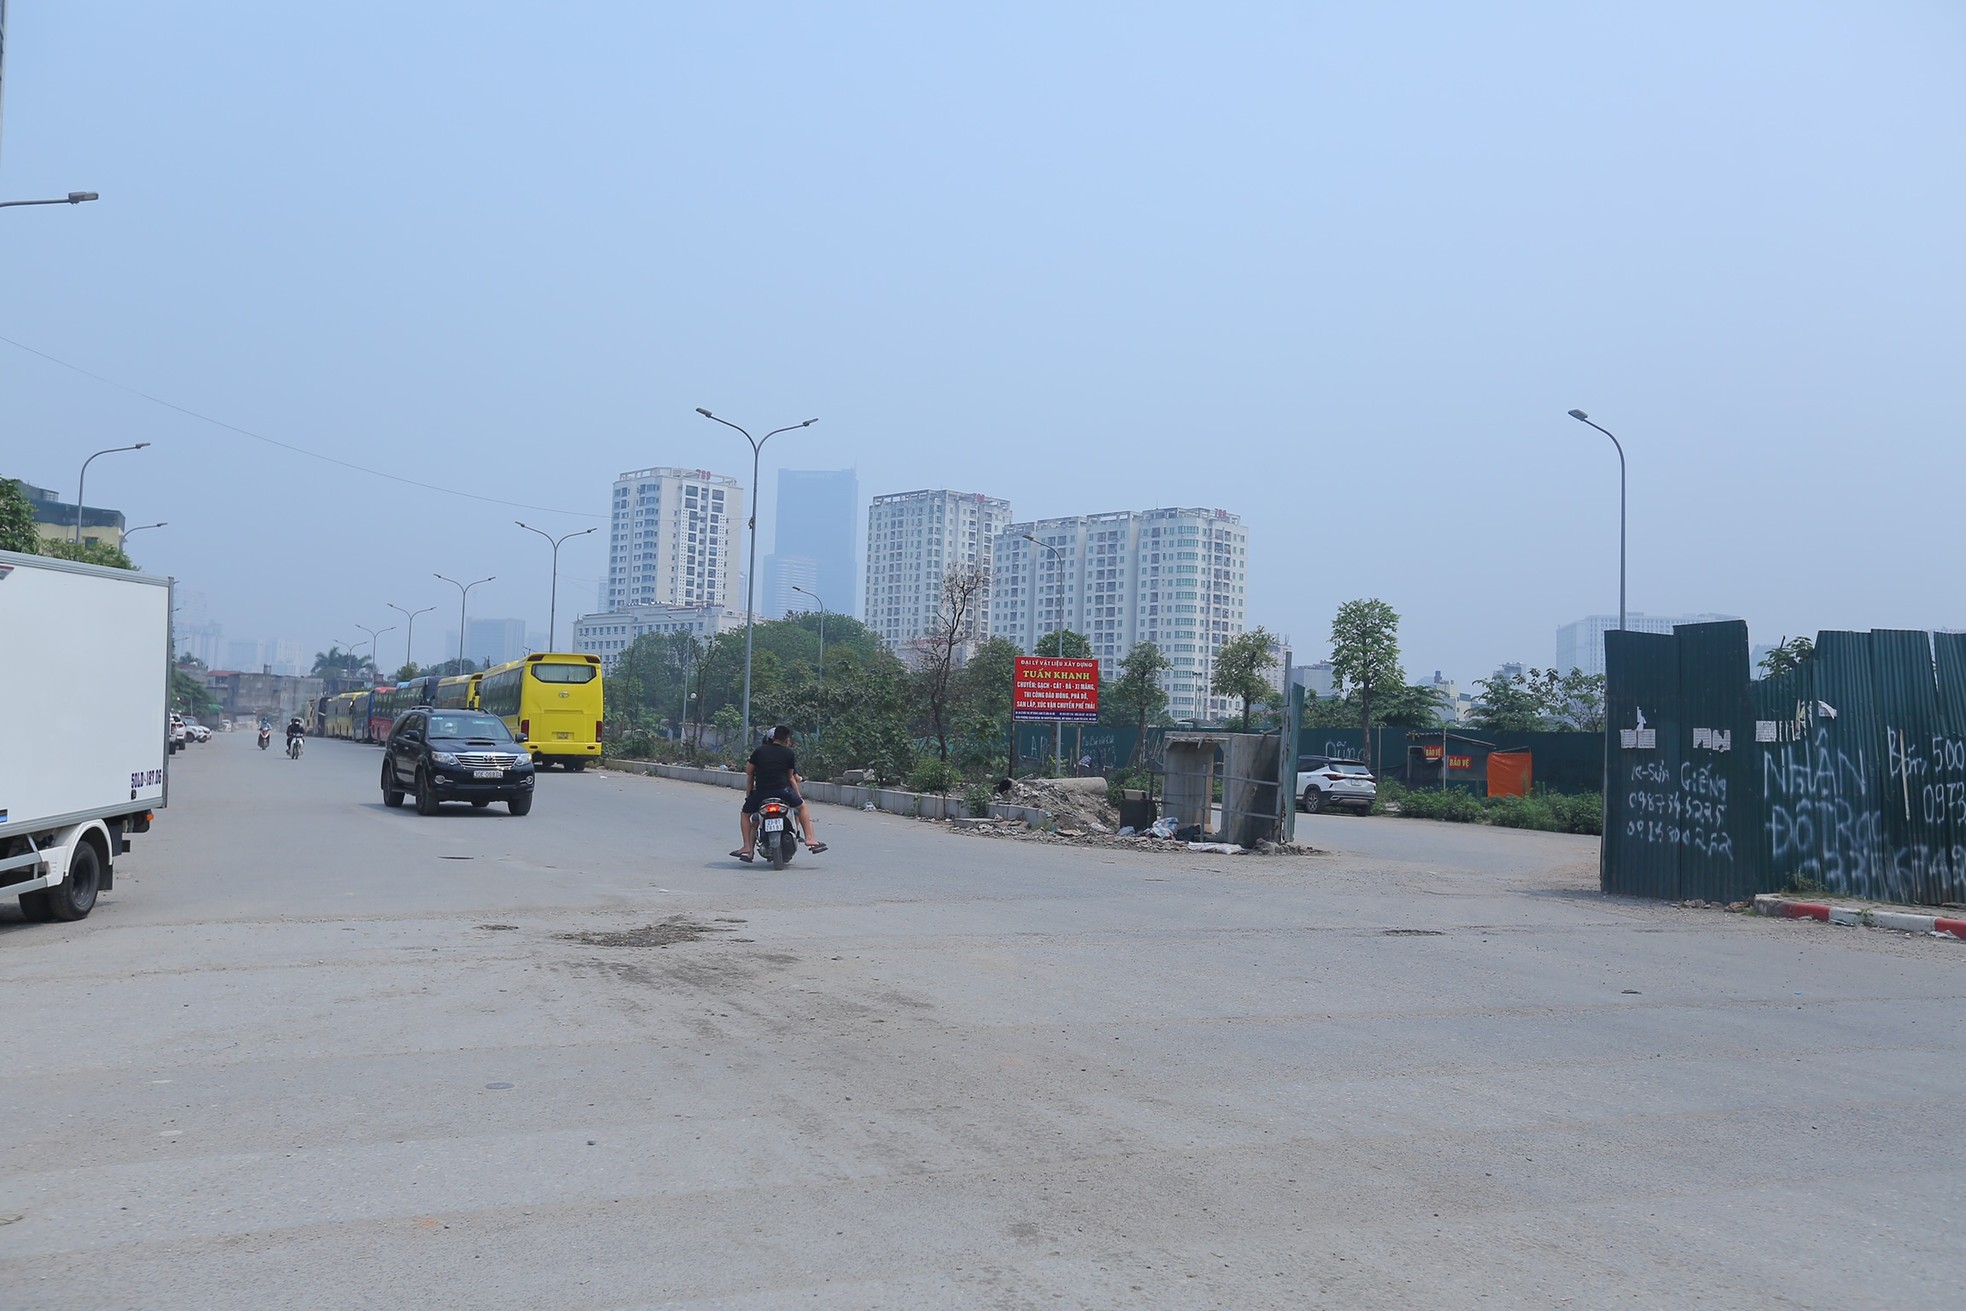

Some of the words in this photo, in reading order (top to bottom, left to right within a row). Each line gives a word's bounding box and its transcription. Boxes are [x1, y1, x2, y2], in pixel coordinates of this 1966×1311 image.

[1023, 668, 1051, 679] TUẤN
[1053, 671, 1090, 680] KHANH
[1016, 700, 1026, 708] SAN
